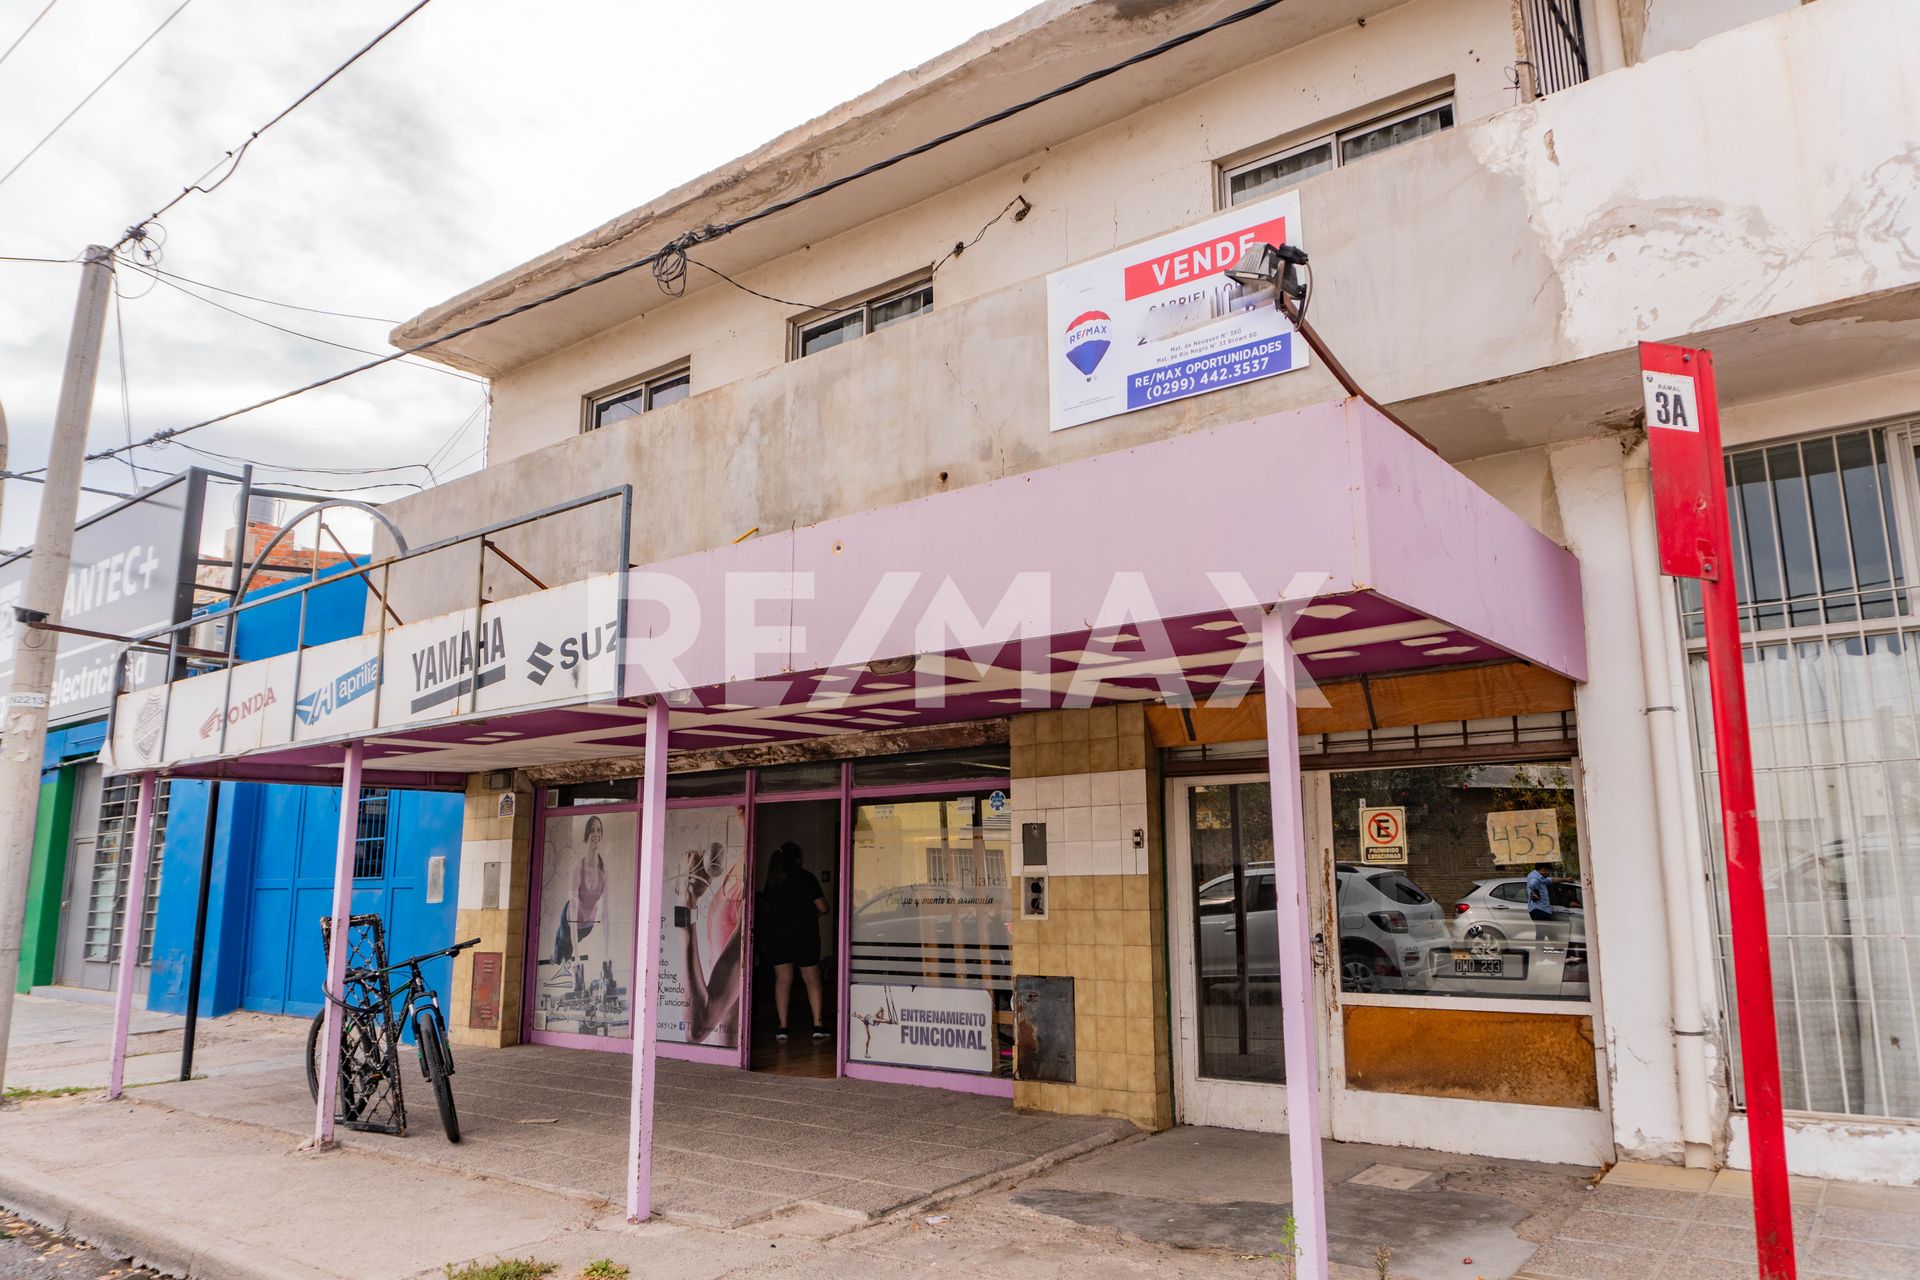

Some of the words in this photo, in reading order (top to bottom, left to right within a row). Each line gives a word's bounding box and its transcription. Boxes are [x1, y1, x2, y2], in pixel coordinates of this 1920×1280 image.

[1069, 325, 1107, 345] RE/MAX
[1135, 367, 1182, 388] RE/MAX
[1185, 340, 1282, 374] OPORTUNIDADES
[1146, 376, 1195, 400] (0299)
[1200, 357, 1269, 385] 442.3537
[1655, 391, 1688, 427] 3A
[411, 616, 506, 692] YAMAHA
[339, 662, 379, 700] aprilia
[1491, 822, 1555, 862] 455
[1481, 960, 1501, 973] 233
[900, 1008, 987, 1027] ENTRENAMIENTO
[900, 1025, 988, 1051] FUNCIONAL
